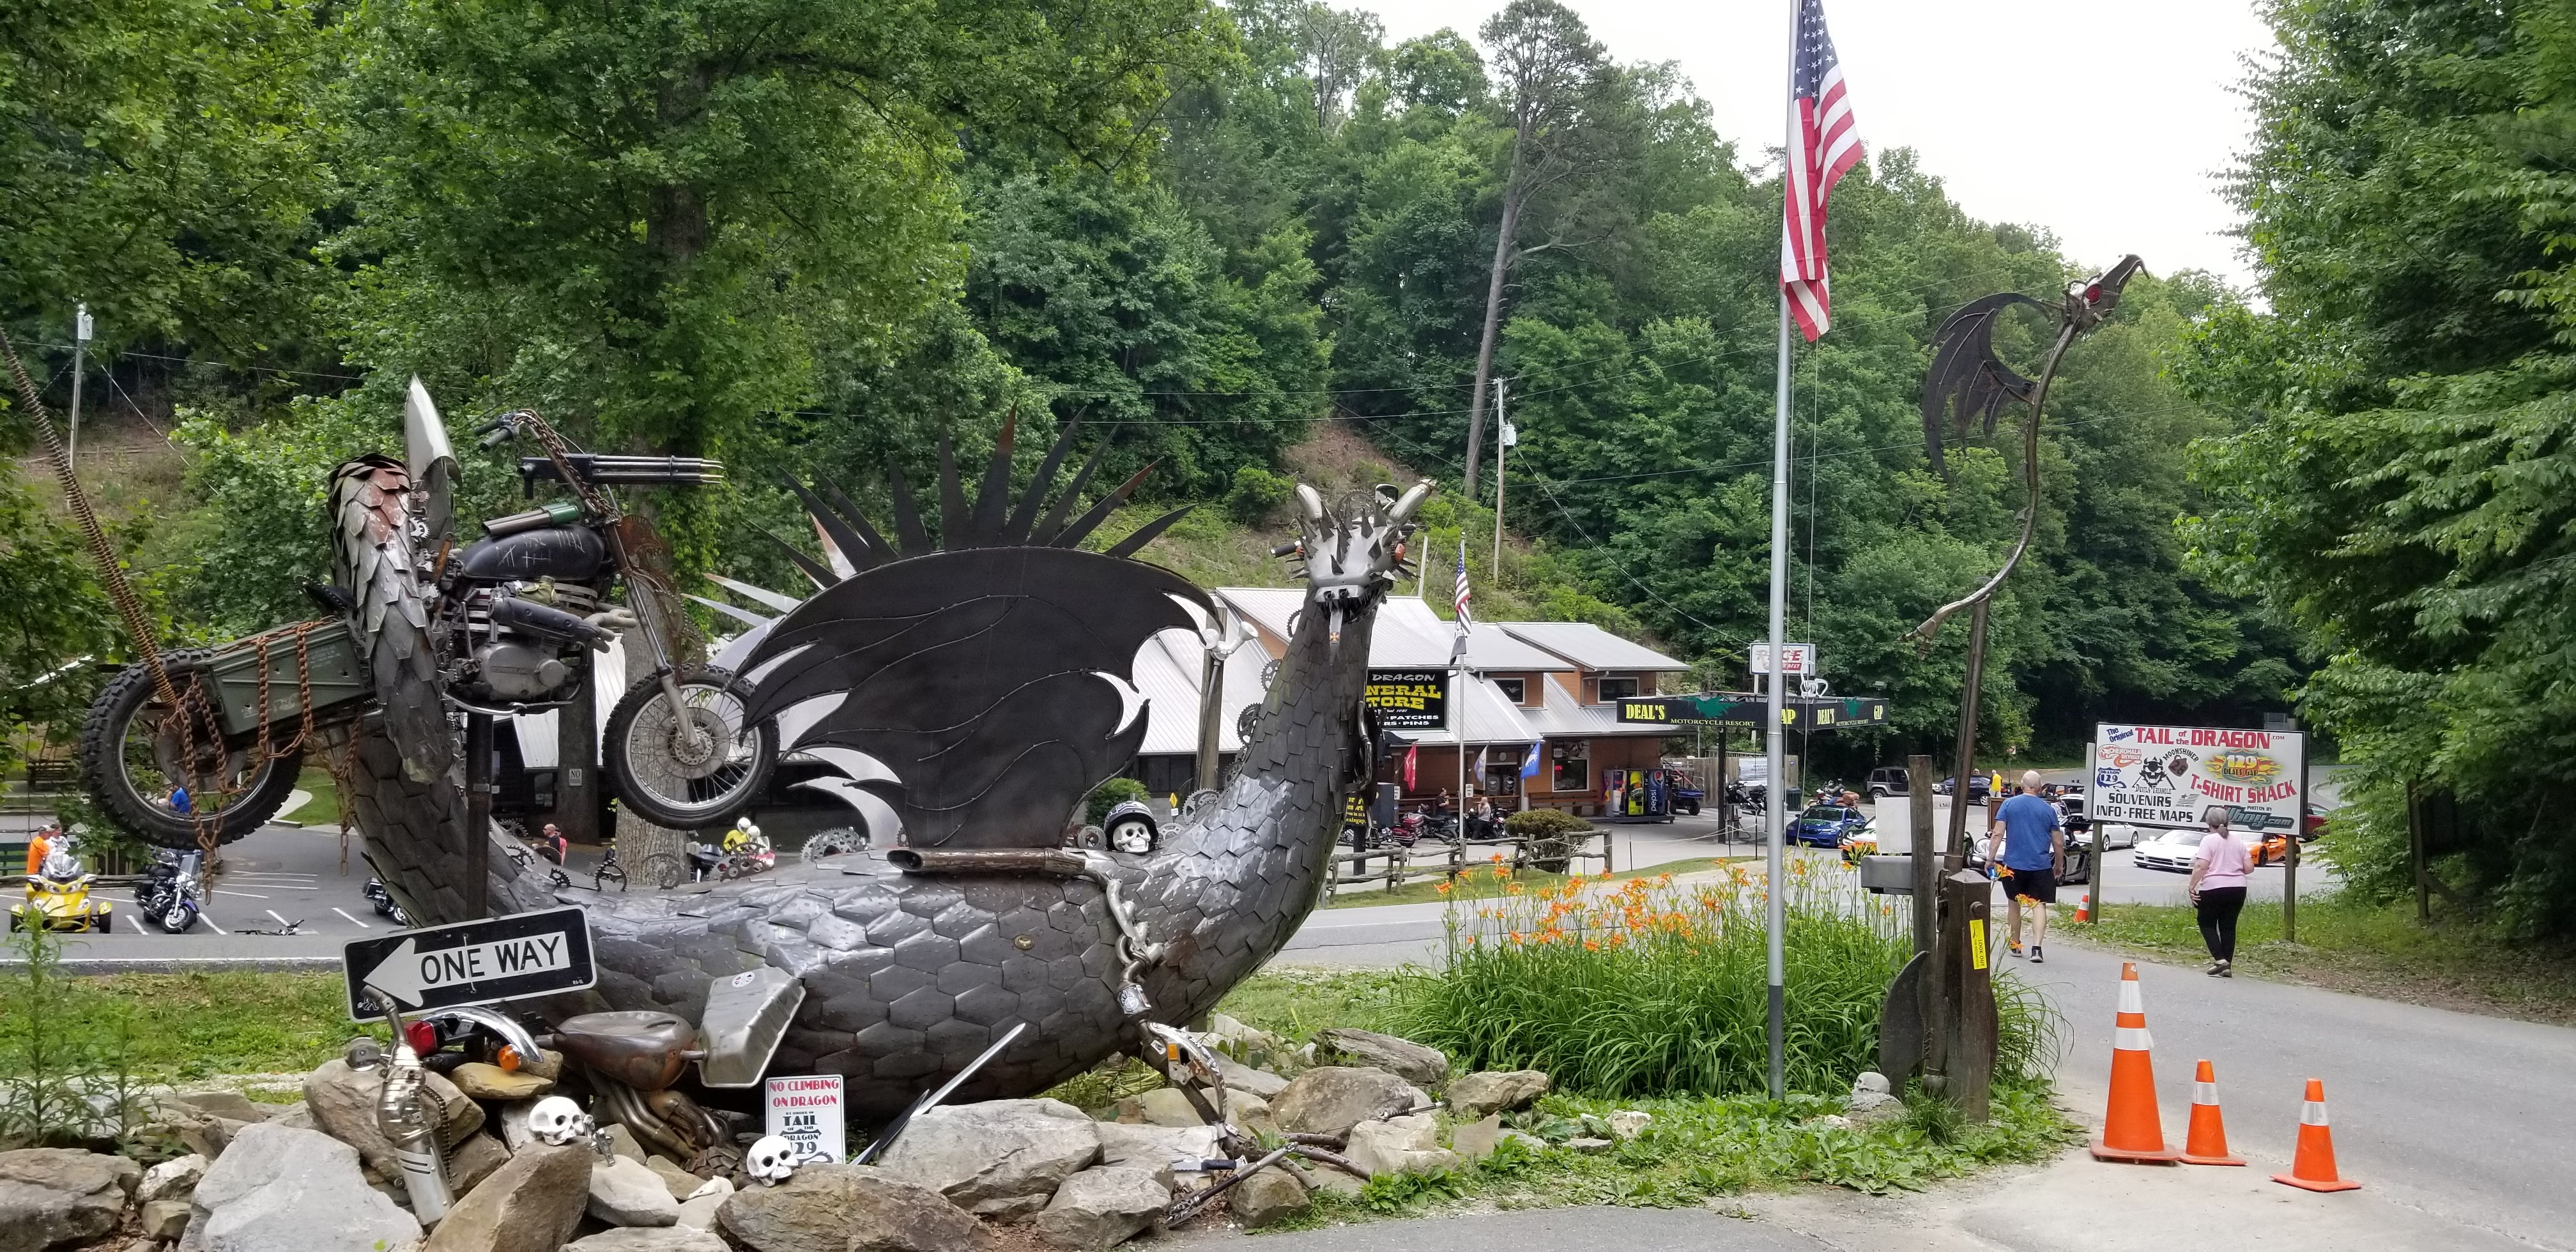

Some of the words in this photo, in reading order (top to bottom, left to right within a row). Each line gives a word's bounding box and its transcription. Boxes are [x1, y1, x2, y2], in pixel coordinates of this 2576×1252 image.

[1365, 685, 1441, 699] NERAL
[1366, 696, 1424, 710] TORE
[1625, 704, 1665, 720] DEAL'S
[1781, 708, 1796, 724] AP
[1817, 708, 1835, 725] DEAL'S
[1874, 705, 1883, 720] GAP
[2106, 728, 2119, 736] The
[2109, 729, 2134, 743] Original
[2135, 727, 2174, 745] TAIL
[2191, 729, 2271, 749] DRAGON
[2163, 748, 2199, 763] MOONSHINER
[2227, 755, 2257, 768] 129
[571, 770, 581, 778] NO
[2191, 774, 2243, 803] T-SHIRT
[2248, 779, 2297, 803] SHACK
[2109, 793, 2172, 807] SOUVENIRS
[2096, 805, 2122, 817] INFO
[2129, 807, 2156, 820] FREE
[2159, 809, 2193, 823] MAPS
[421, 948, 485, 984] ONE
[494, 936, 560, 973] WAY
[769, 1081, 785, 1092] NO
[788, 1079, 839, 1091] CLIMBING
[773, 1097, 788, 1107] ON
[790, 1095, 837, 1106] DRAGON
[783, 1115, 818, 1126] TAIL
